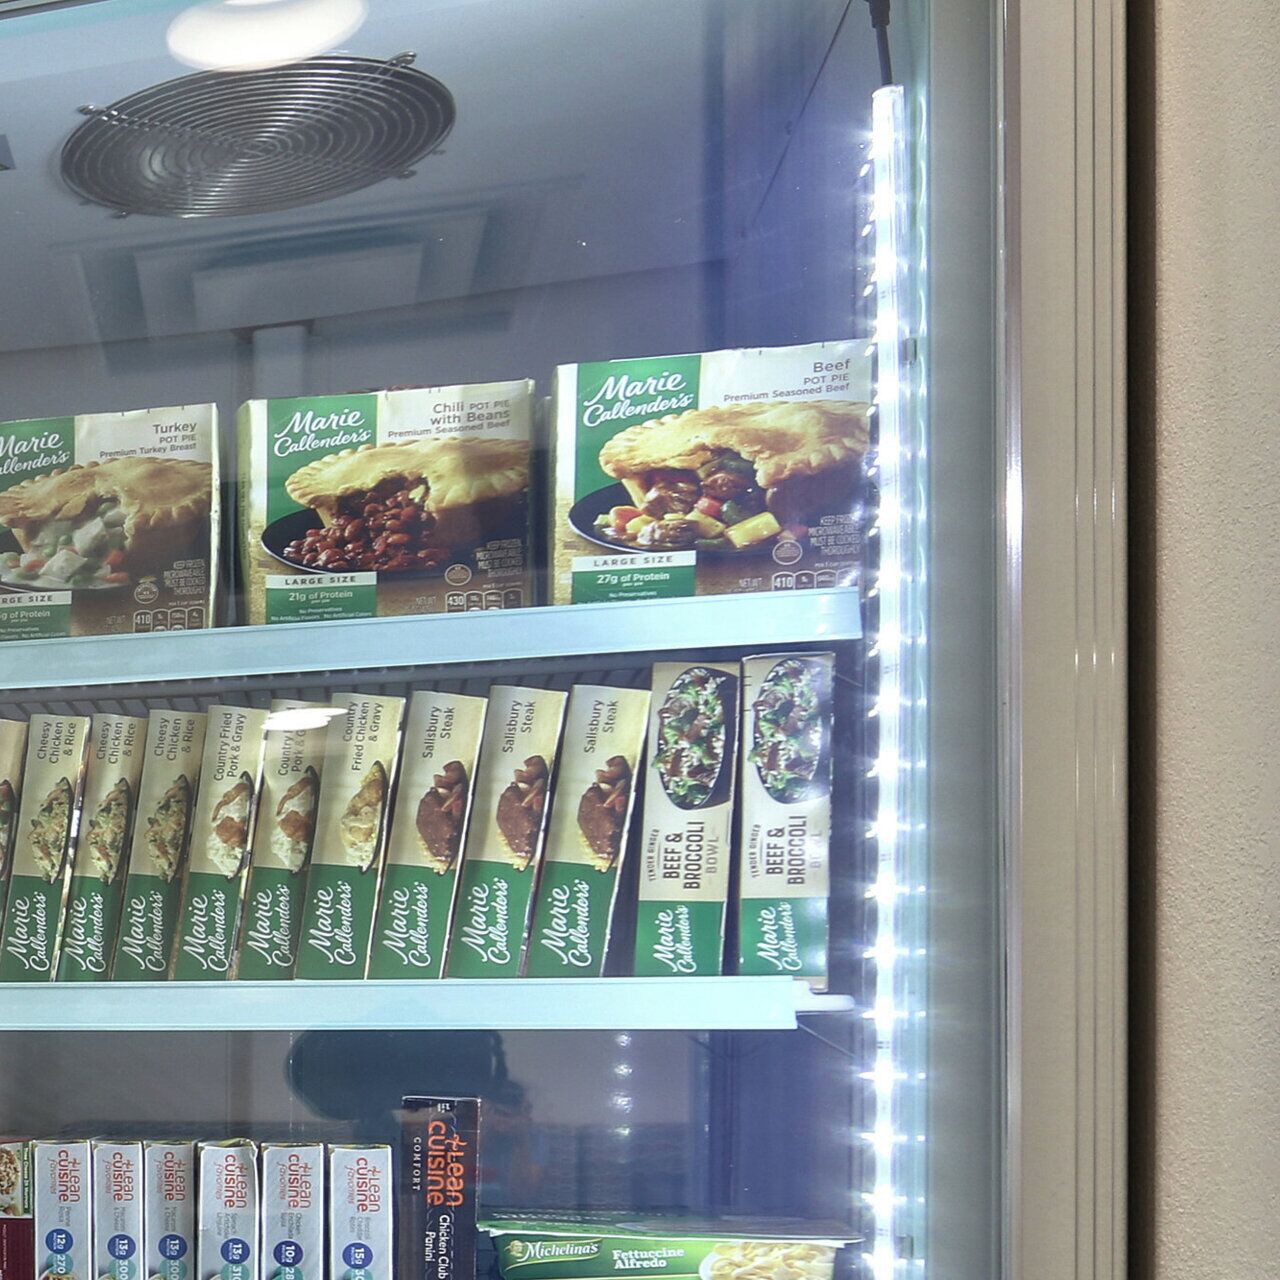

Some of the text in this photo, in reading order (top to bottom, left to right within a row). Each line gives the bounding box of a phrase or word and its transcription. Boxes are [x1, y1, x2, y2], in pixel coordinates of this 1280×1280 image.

[804, 373, 849, 385] POT PIE
[813, 359, 851, 373] Beef
[584, 371, 686, 407] Marie
[724, 383, 850, 401] Premium Seasoned Beef
[274, 408, 364, 438] Marie
[430, 408, 510, 426] with Beans
[433, 400, 510, 414] Chili POT PIE
[584, 393, 693, 427] Callender's
[153, 421, 197, 434] Turkey
[160, 434, 196, 444] POT PIE
[274, 428, 371, 457] Callender's
[388, 423, 483, 438] Premium Seasoned
[593, 555, 674, 567] LARGE SIZE
[632, 572, 670, 582] Protein
[285, 575, 356, 585] LARGE SIZE
[28, 594, 54, 603] SIZE
[38, 721, 51, 760] Cheesy
[502, 700, 535, 753] Salisbury Steak
[584, 699, 618, 753] Salisbury Steak
[49, 722, 63, 764] Chicken
[663, 844, 681, 880] BEEF
[683, 821, 705, 889] BROCCOLI
[766, 839, 784, 875] BEEF
[788, 816, 807, 886] BROCCOLI
[382, 886, 409, 964] Marie
[407, 881, 431, 967] Callender's
[541, 884, 570, 965] Marie
[568, 879, 591, 967] Callender's
[413, 1137, 421, 1191] COMFORT
[427, 1121, 445, 1206] cuisine
[446, 1148, 463, 1206] Lean
[426, 1231, 436, 1261] Panini
[438, 1214, 450, 1280] Chicken Club
[523, 1242, 600, 1258] Michelina's
[613, 1248, 685, 1261] Fettuccine
[613, 1257, 667, 1270] Alfredo
